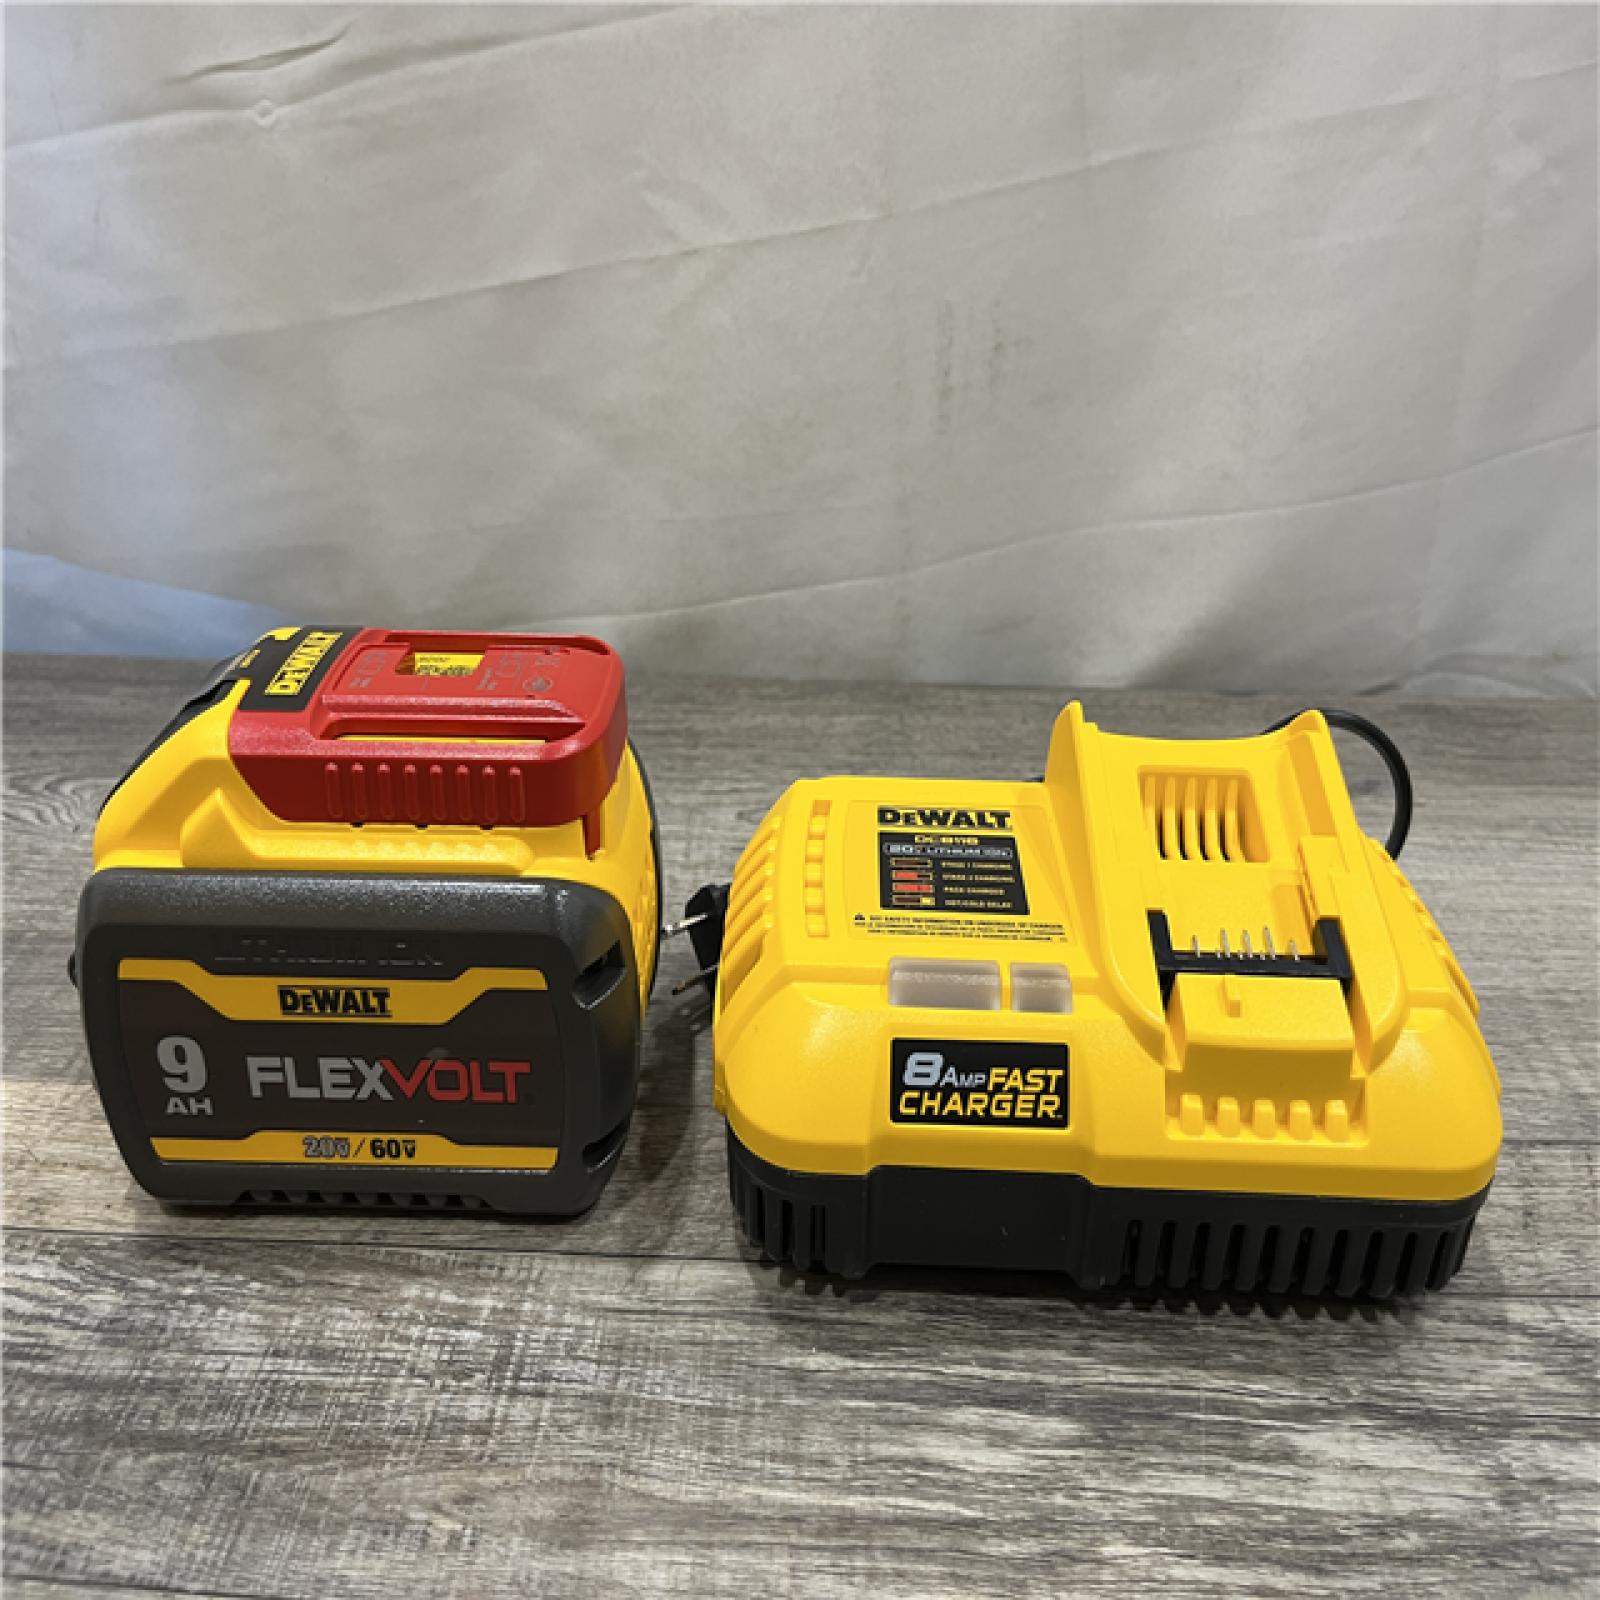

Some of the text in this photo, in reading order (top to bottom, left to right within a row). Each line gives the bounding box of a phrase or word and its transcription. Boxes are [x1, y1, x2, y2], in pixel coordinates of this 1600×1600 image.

[878, 808, 1011, 829] DEWALT
[279, 987, 390, 1015] DEWALT
[156, 1035, 208, 1094] 9
[246, 1055, 532, 1103] FLEXVOLT
[903, 1052, 943, 1087] 8
[987, 1067, 1064, 1093] FAST
[165, 1097, 214, 1116] AH
[900, 1090, 1063, 1119] CHARGER
